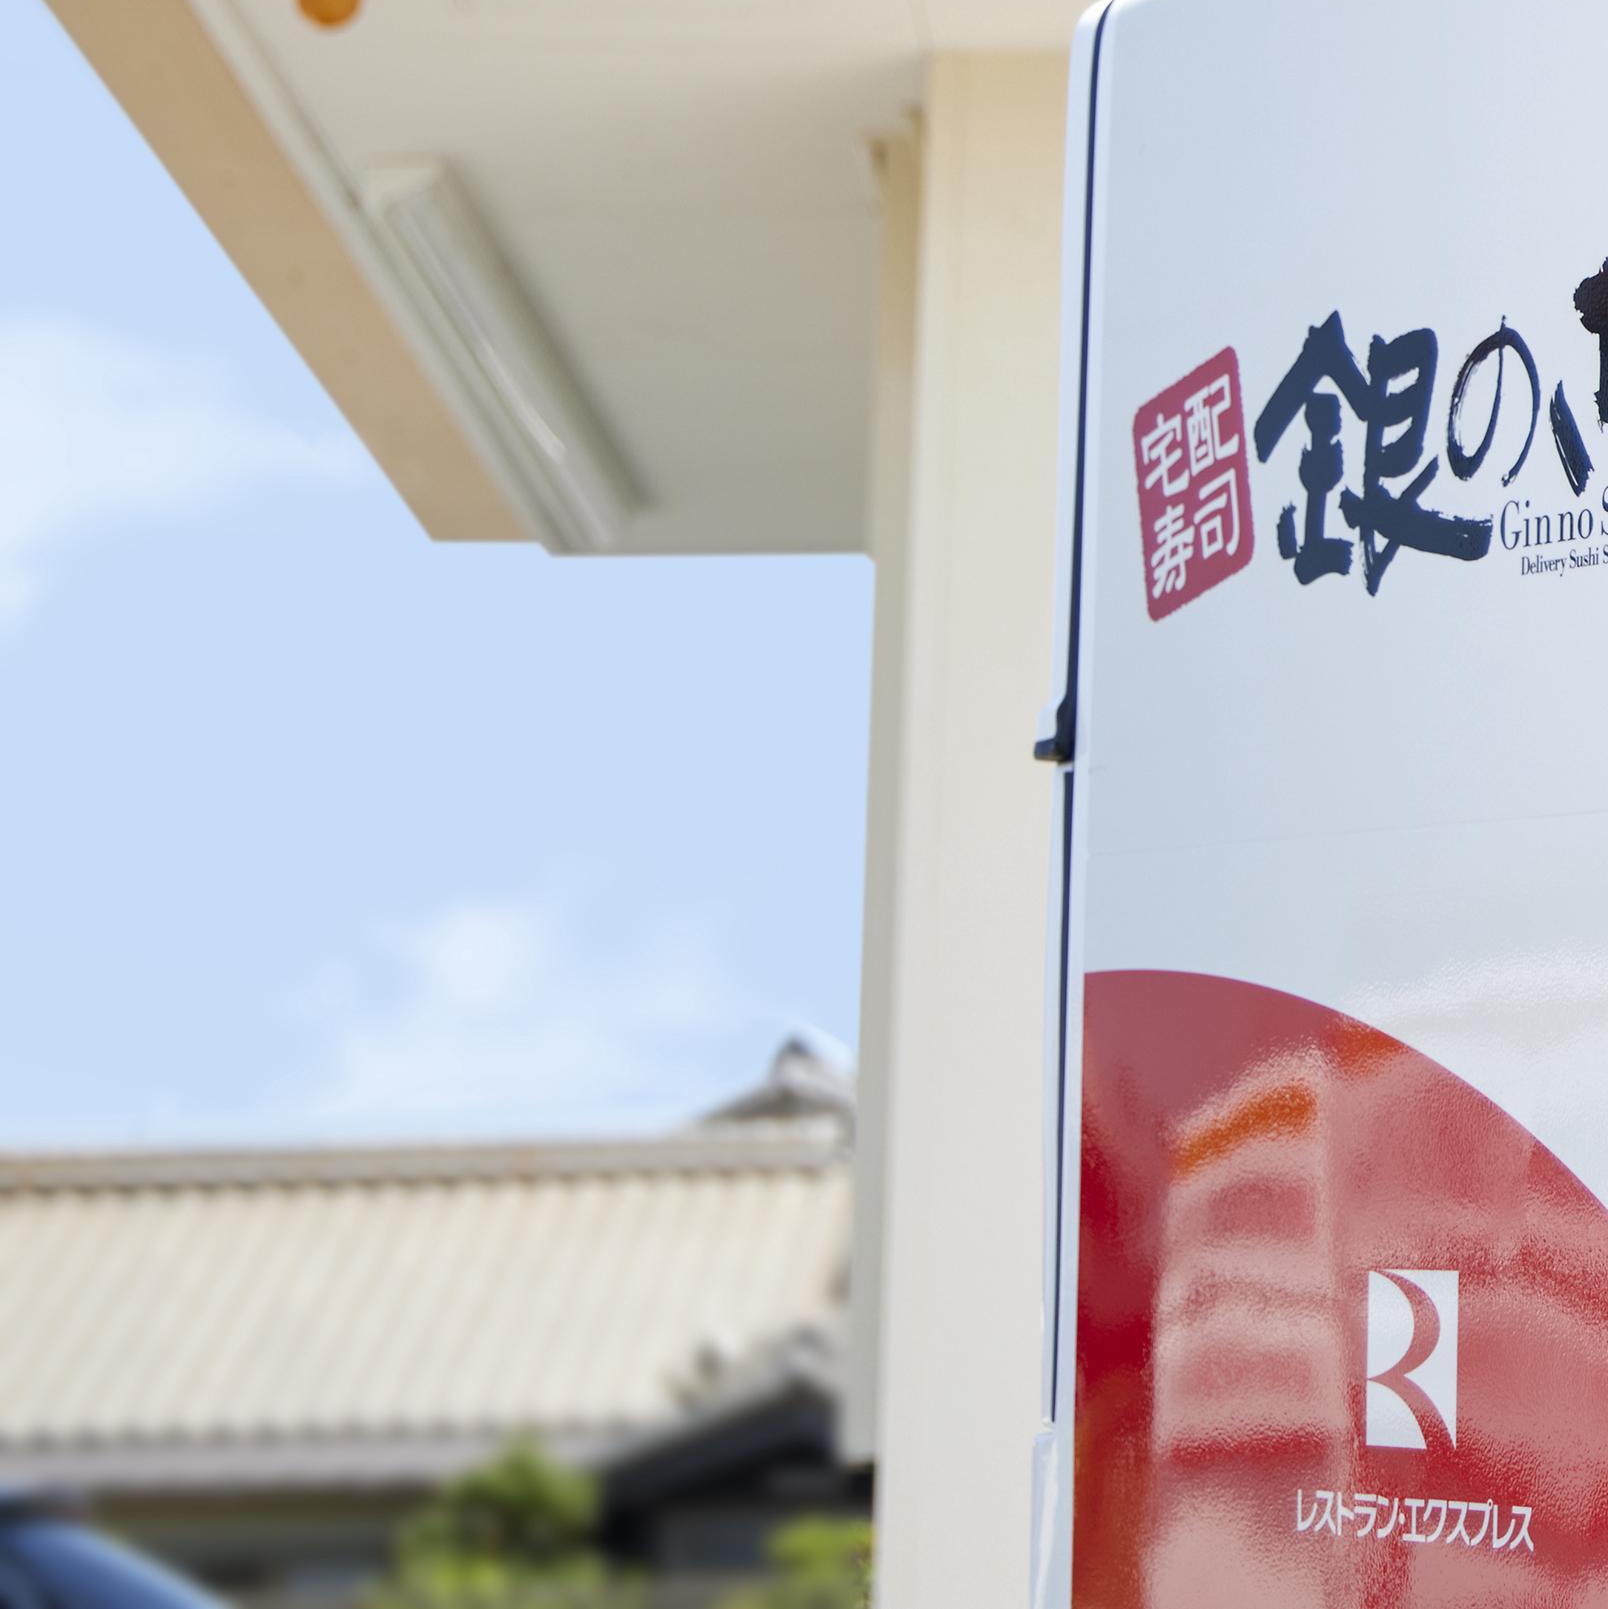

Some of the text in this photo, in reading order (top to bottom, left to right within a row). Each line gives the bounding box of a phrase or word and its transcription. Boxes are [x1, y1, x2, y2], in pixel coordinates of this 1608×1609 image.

[1141, 376, 1239, 495] 宅配
[1500, 499, 1552, 551] Gin
[1557, 508, 1594, 543] no
[1521, 555, 1567, 577] Delivery
[1569, 547, 1599, 569] Sushi
